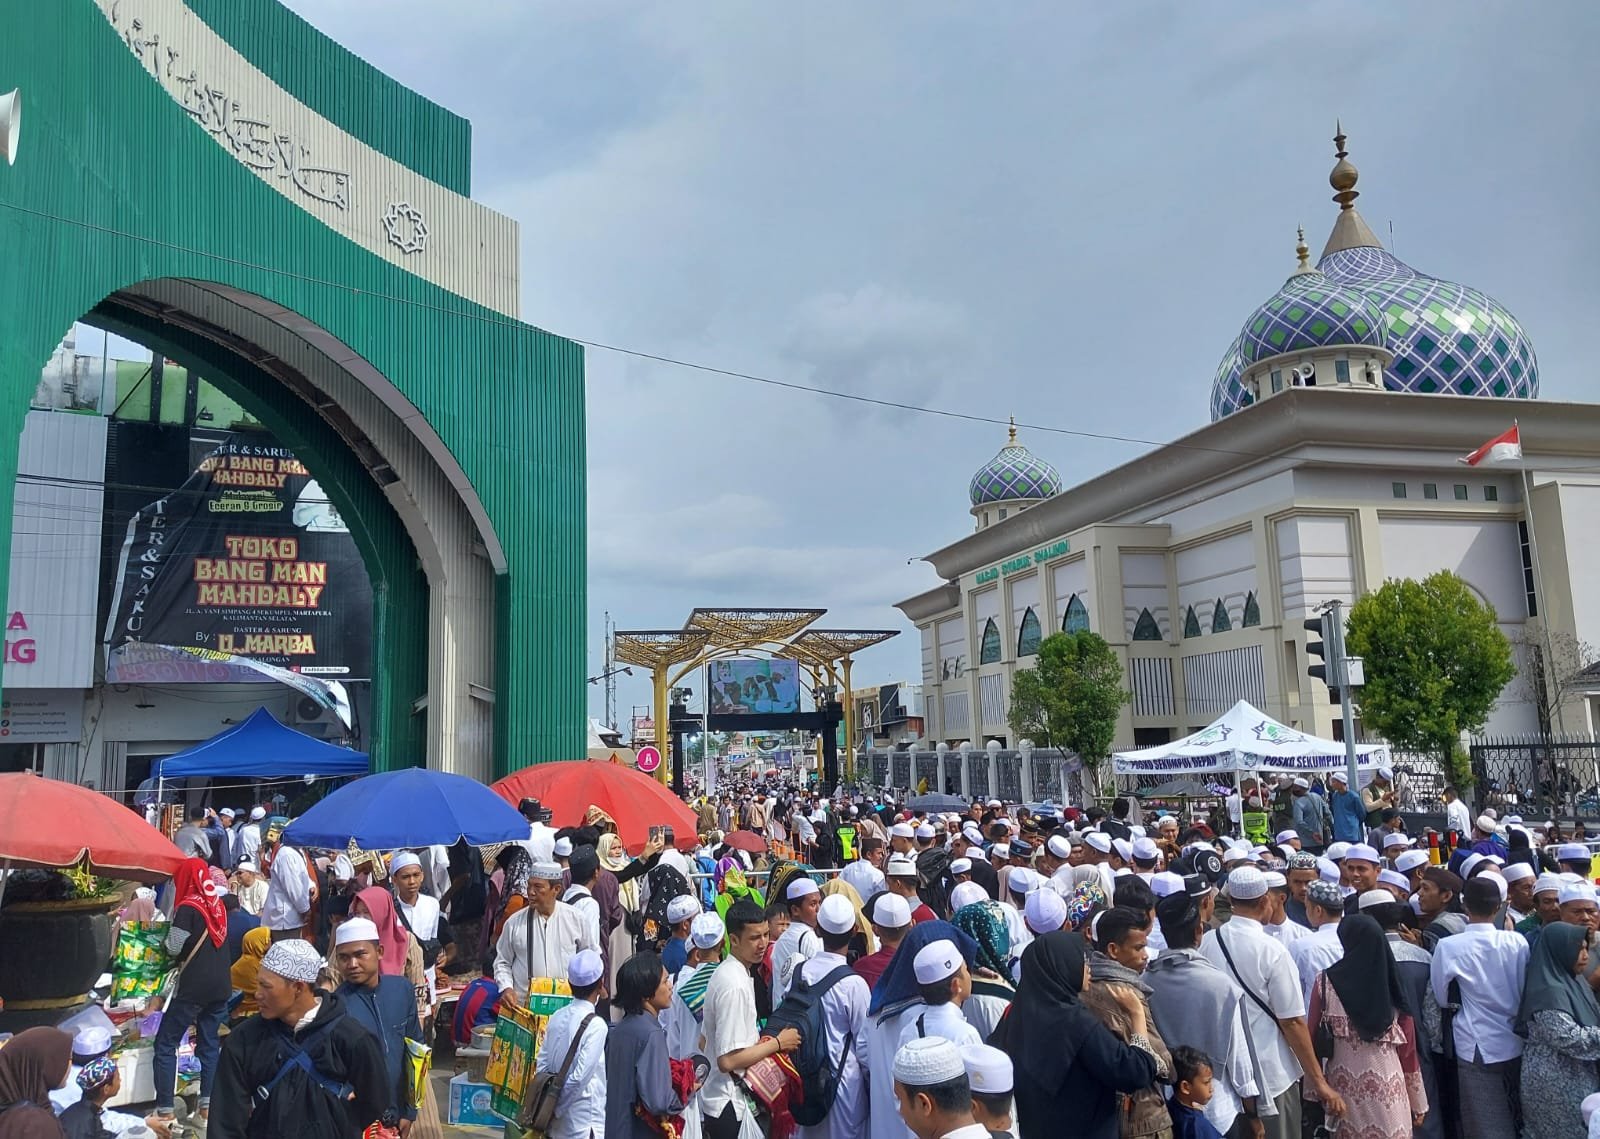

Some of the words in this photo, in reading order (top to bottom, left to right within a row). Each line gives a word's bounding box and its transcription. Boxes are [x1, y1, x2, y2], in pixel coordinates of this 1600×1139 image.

[241, 445, 251, 455] &
[230, 456, 274, 473] BANG
[226, 536, 298, 560] TOKO
[194, 559, 267, 582] BANG
[271, 561, 327, 585] MAN
[197, 583, 323, 608] MAHDALY
[195, 631, 210, 643] By
[4, 638, 36, 664] G
[252, 655, 290, 663] KALONGAN
[1130, 759, 1154, 771] POSKO
[1192, 755, 1217, 768] DEPAN
[1263, 755, 1295, 767] POSKO
